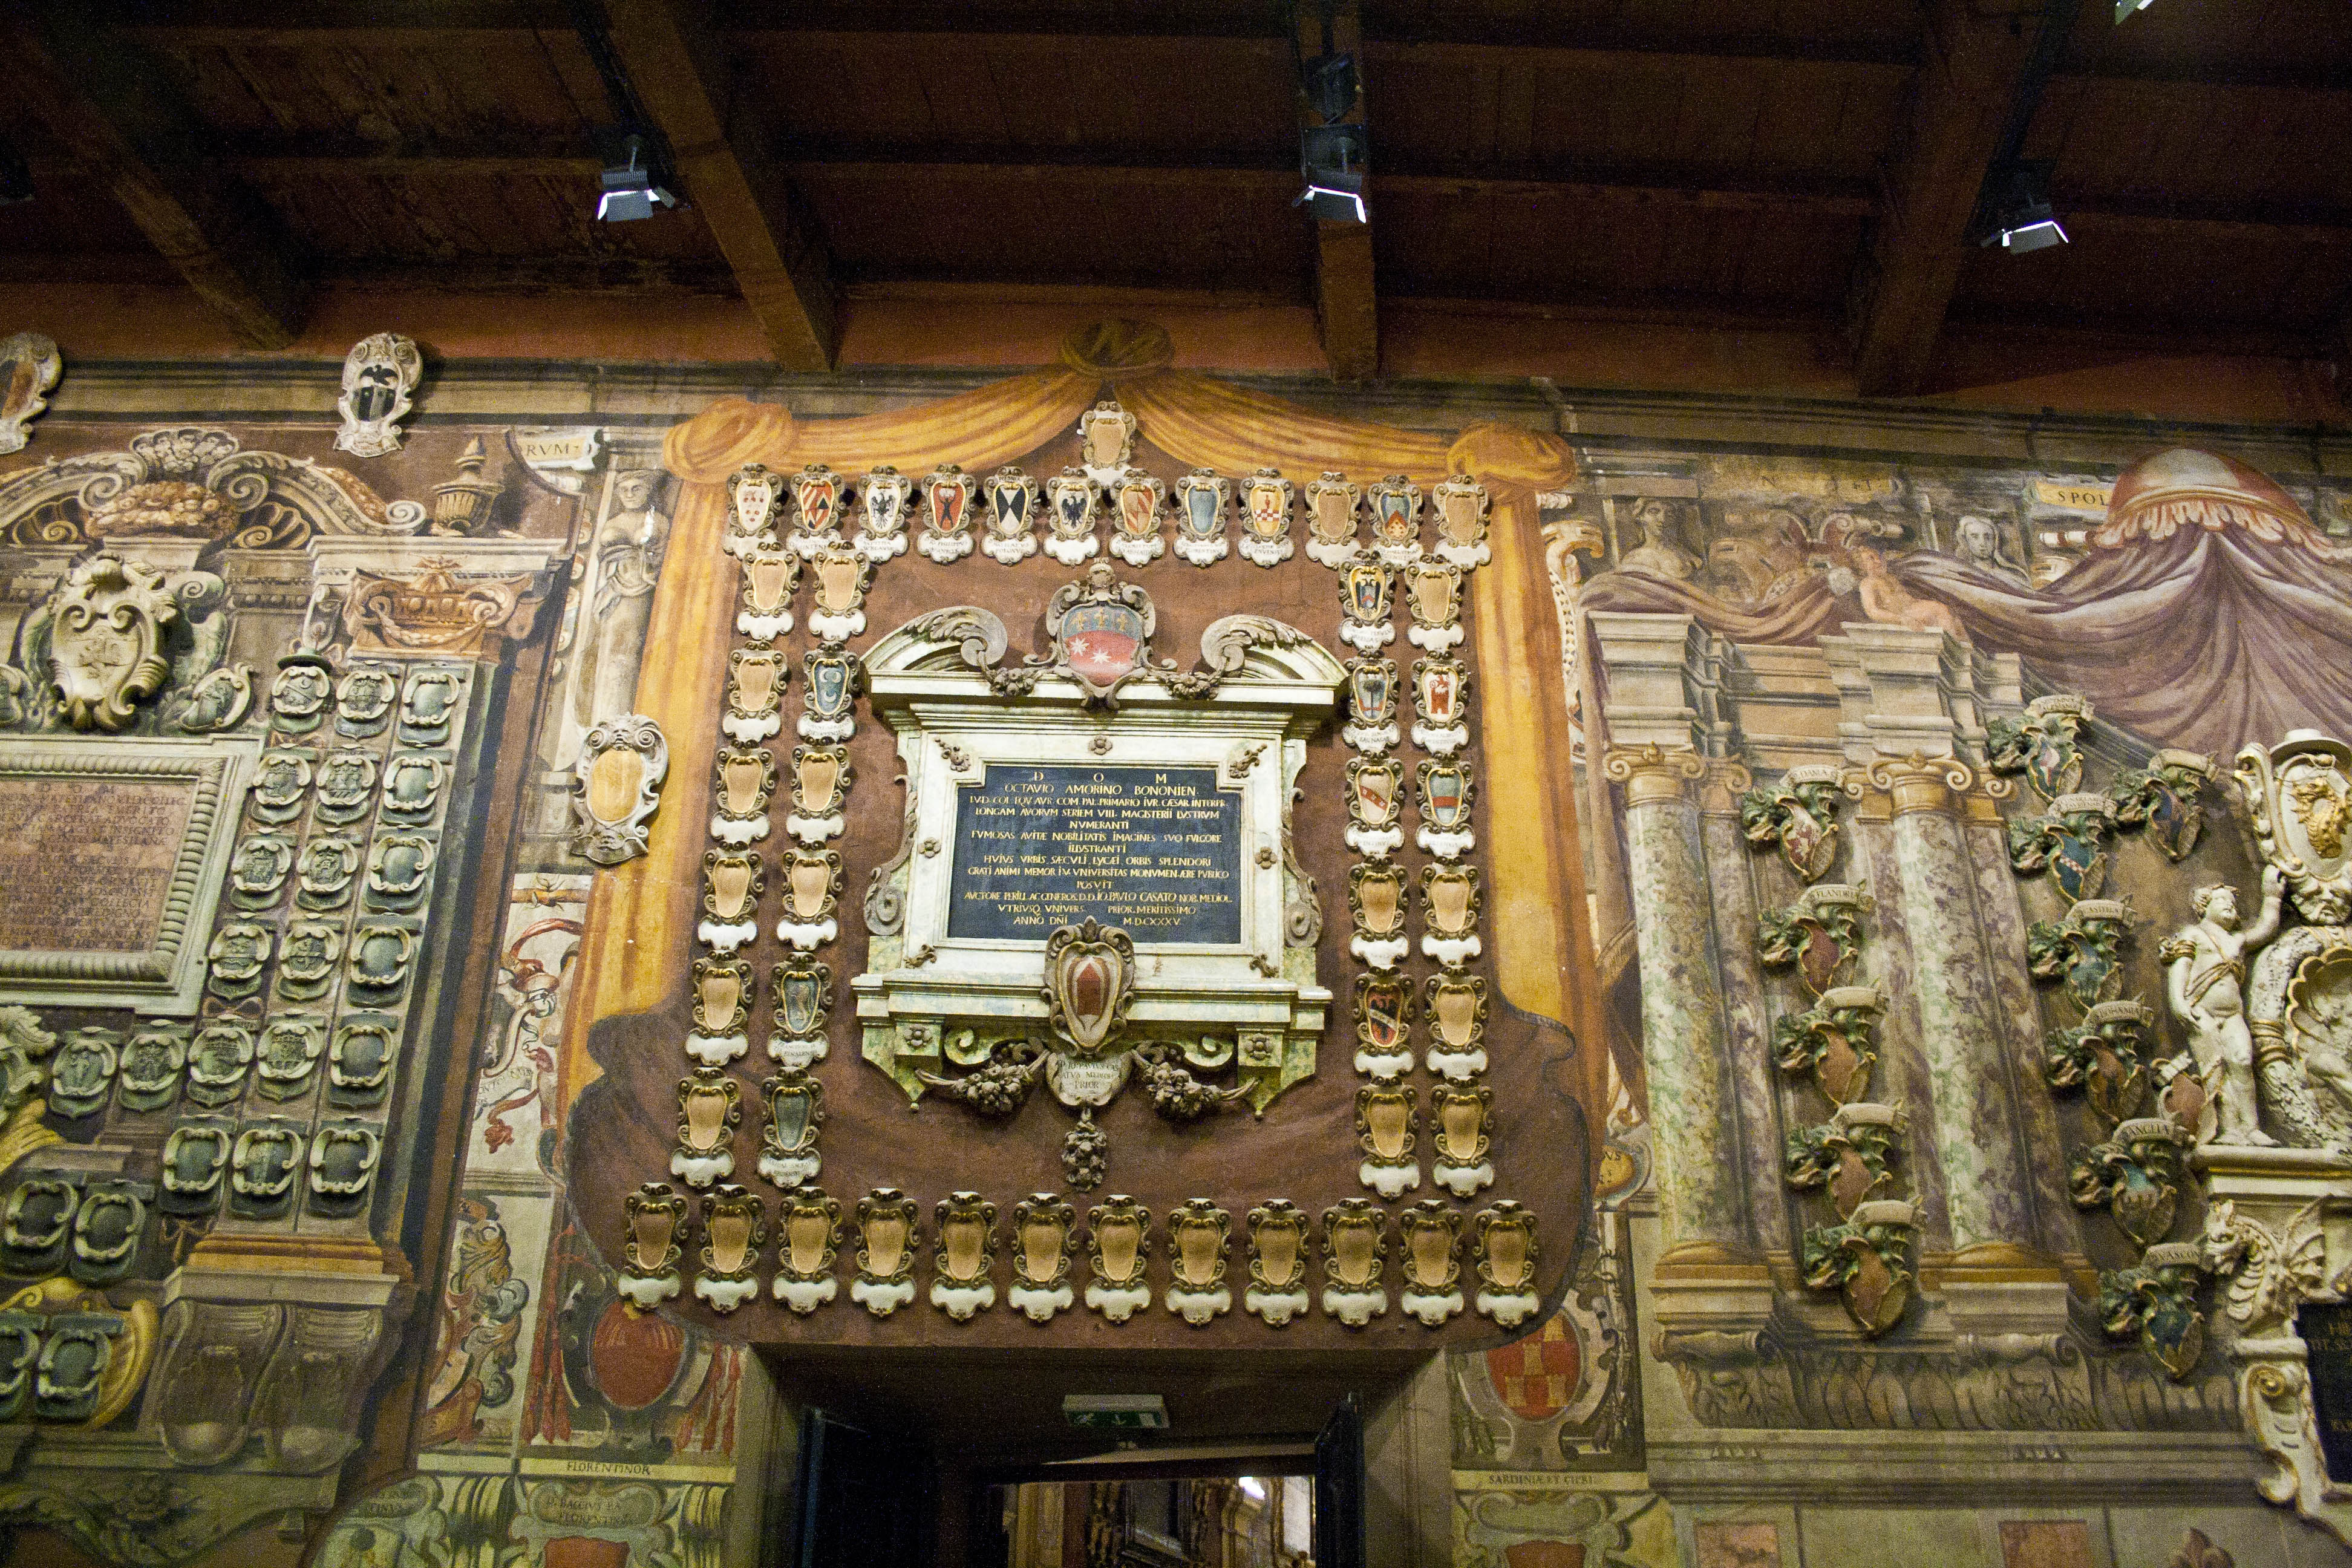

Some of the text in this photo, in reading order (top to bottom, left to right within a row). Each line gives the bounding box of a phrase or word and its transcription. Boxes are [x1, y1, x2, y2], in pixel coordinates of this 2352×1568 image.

[1034, 771, 1167, 784] D O M
[1004, 783, 1054, 794] OCTAVIO
[1065, 783, 1122, 794] AMORINO
[975, 806, 1016, 816] LONGAM
[1070, 820, 1129, 829] NVMERANTI
[1163, 834, 1183, 843] SVO
[984, 854, 1014, 863] HVIVS
[1126, 856, 1152, 866] ORBIS
[1158, 857, 1211, 866] SPLENDORI
[968, 865, 992, 875] GRATI
[994, 866, 1021, 876] ANIMI
[1024, 867, 1056, 876] MEMOR
[1139, 892, 1177, 902] CASATO
